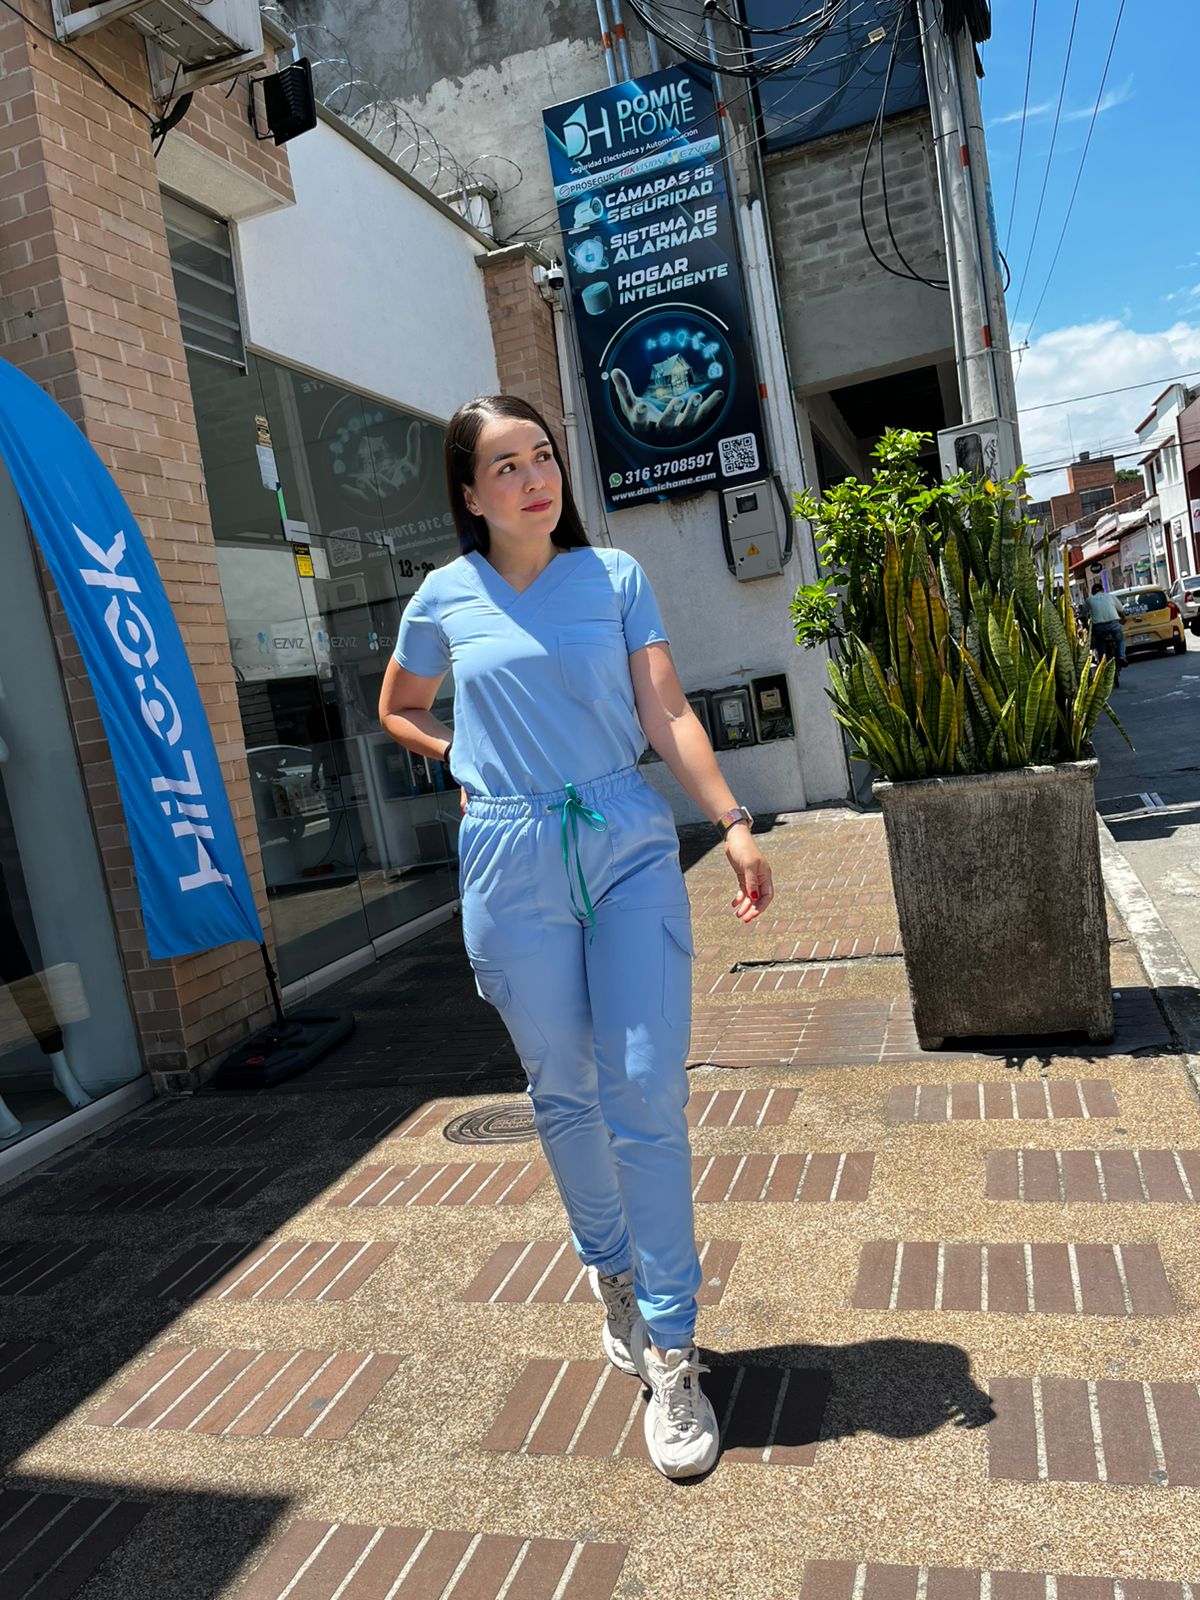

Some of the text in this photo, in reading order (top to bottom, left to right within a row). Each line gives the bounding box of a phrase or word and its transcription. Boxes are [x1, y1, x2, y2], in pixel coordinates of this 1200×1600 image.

[616, 78, 692, 120] DOMIC
[618, 97, 696, 143] HOME
[570, 159, 603, 175] Seguridad
[602, 146, 640, 163] Electrónica
[640, 145, 645, 153] y
[570, 173, 616, 193] PROSEGUR
[605, 164, 715, 207] CÁMARAS DE
[607, 180, 713, 224] SEGURIDAD
[610, 205, 718, 249] SISTEMA DE
[613, 220, 718, 264] ALARMAS
[617, 257, 689, 290] HOGAR
[619, 263, 729, 305] INTELIGENTE
[612, 472, 717, 502] www.domichome.com
[625, 452, 714, 485] 316 3708597
[273, 637, 305, 649] EZVIZ
[330, 636, 359, 648] EZVIZ
